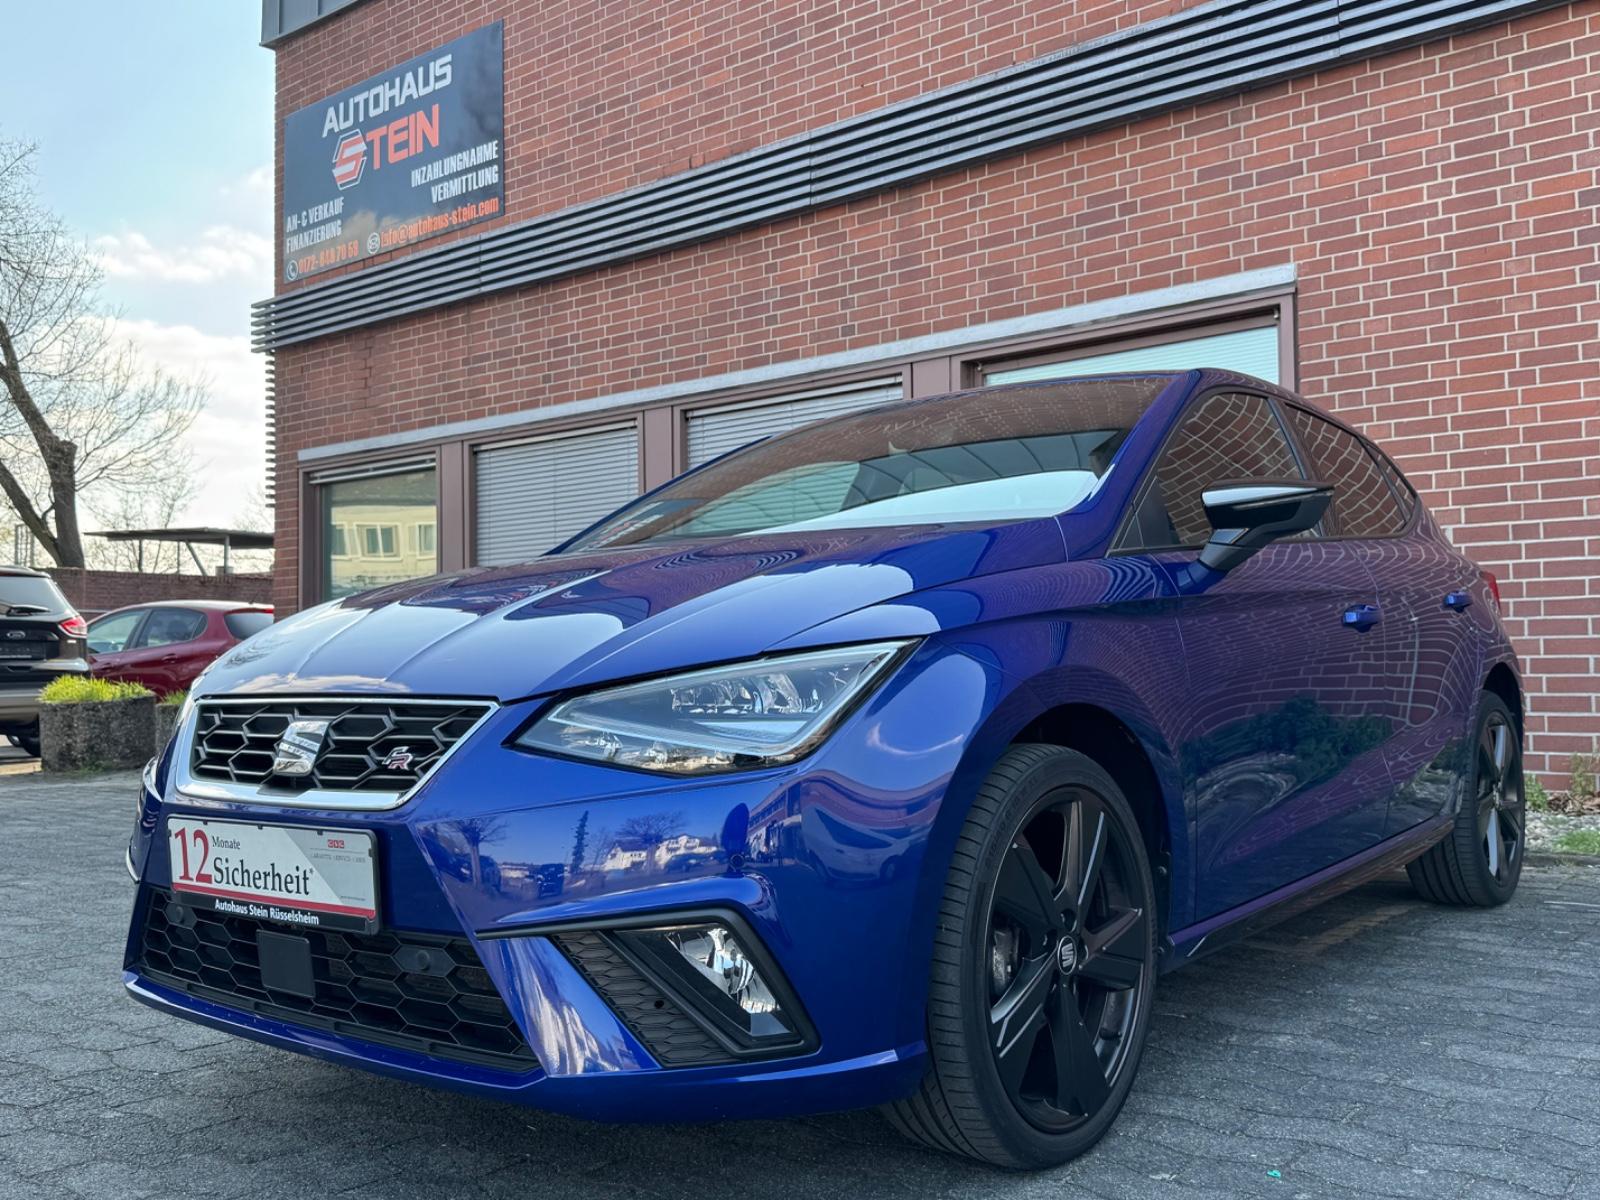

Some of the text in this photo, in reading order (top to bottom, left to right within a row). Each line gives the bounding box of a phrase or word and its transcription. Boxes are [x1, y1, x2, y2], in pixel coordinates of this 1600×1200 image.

[321, 53, 453, 138] AUTOHAUS
[332, 103, 440, 186] STEIN
[411, 139, 499, 188] INZAHLUNGNAHME
[431, 164, 499, 204] VERMITTLUNG
[308, 197, 344, 224] VERKAUF
[286, 220, 342, 253] FINANZIERUNG
[174, 827, 241, 885] 12 Monate
[214, 898, 320, 926] Autohaus Stein Rüsselsheim
